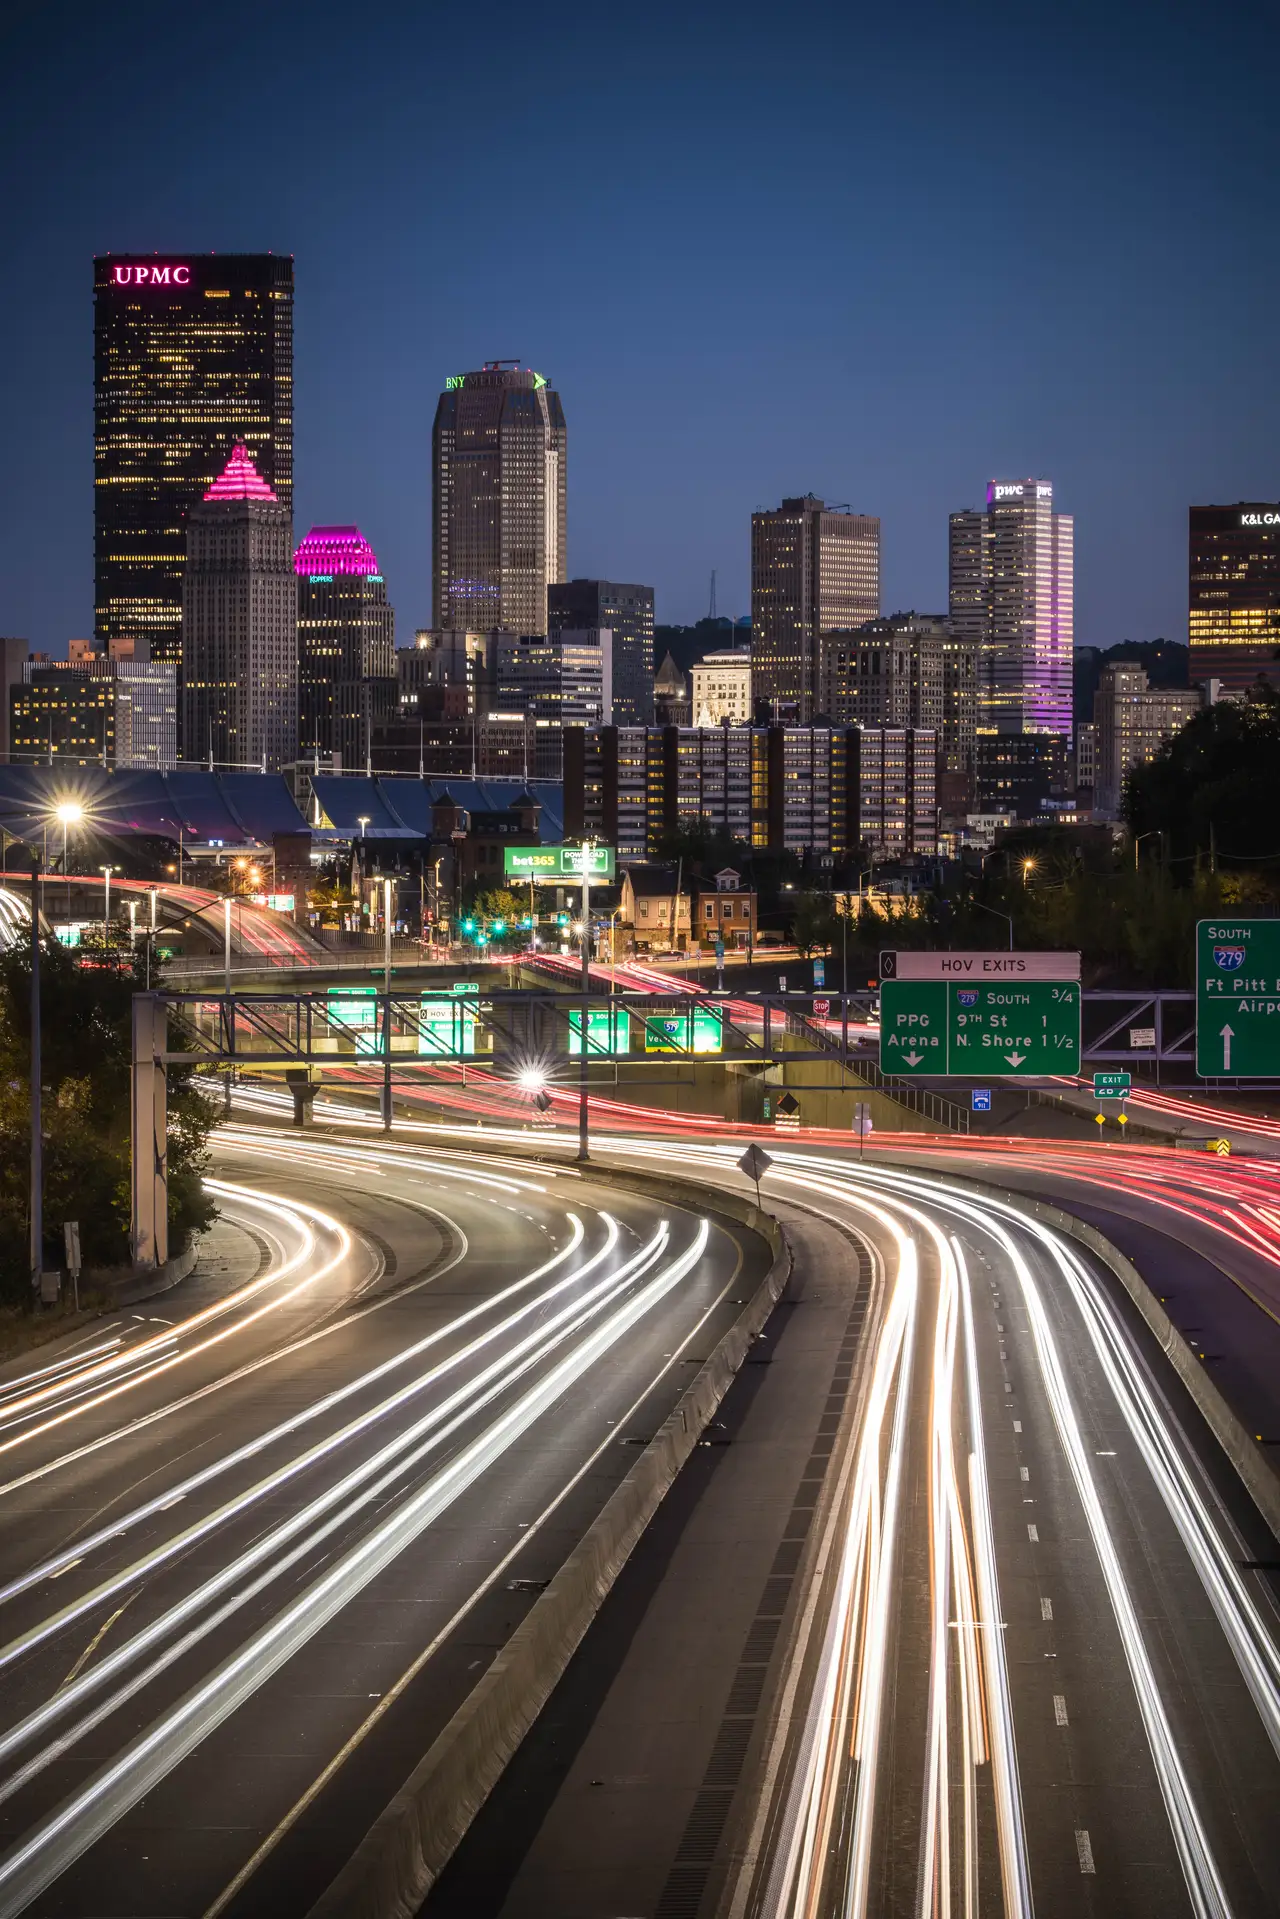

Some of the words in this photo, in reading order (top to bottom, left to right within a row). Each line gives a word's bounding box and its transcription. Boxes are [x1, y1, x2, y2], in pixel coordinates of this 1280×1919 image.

[114, 266, 190, 284] UPMC
[446, 376, 465, 389] BNY
[995, 485, 1024, 499] pwc
[1036, 485, 1052, 498] pwc
[1241, 513, 1263, 525] K&L
[309, 575, 333, 583] KOPPERS
[513, 856, 554, 865] bet365
[1208, 927, 1251, 939] SOUTH
[941, 959, 973, 972] HOV
[983, 959, 1026, 972] EXITS
[1219, 952, 1243, 966] 279
[1206, 979, 1224, 991] Ft
[1233, 979, 1266, 991] Pitt
[961, 994, 975, 1003] 279
[986, 993, 1030, 1005] SOUTH
[1051, 989, 1073, 1003] 3/4
[814, 1002, 829, 1010] STOP
[897, 1014, 929, 1026] PPG
[957, 1014, 982, 1027] 9TH
[989, 1014, 1008, 1027] St
[1042, 1015, 1047, 1027] 1
[888, 1033, 939, 1047] Arena
[956, 1034, 972, 1047] N.
[981, 1033, 1033, 1047] Shore
[1042, 1034, 1047, 1047] 1
[1053, 1034, 1074, 1049] 1/2
